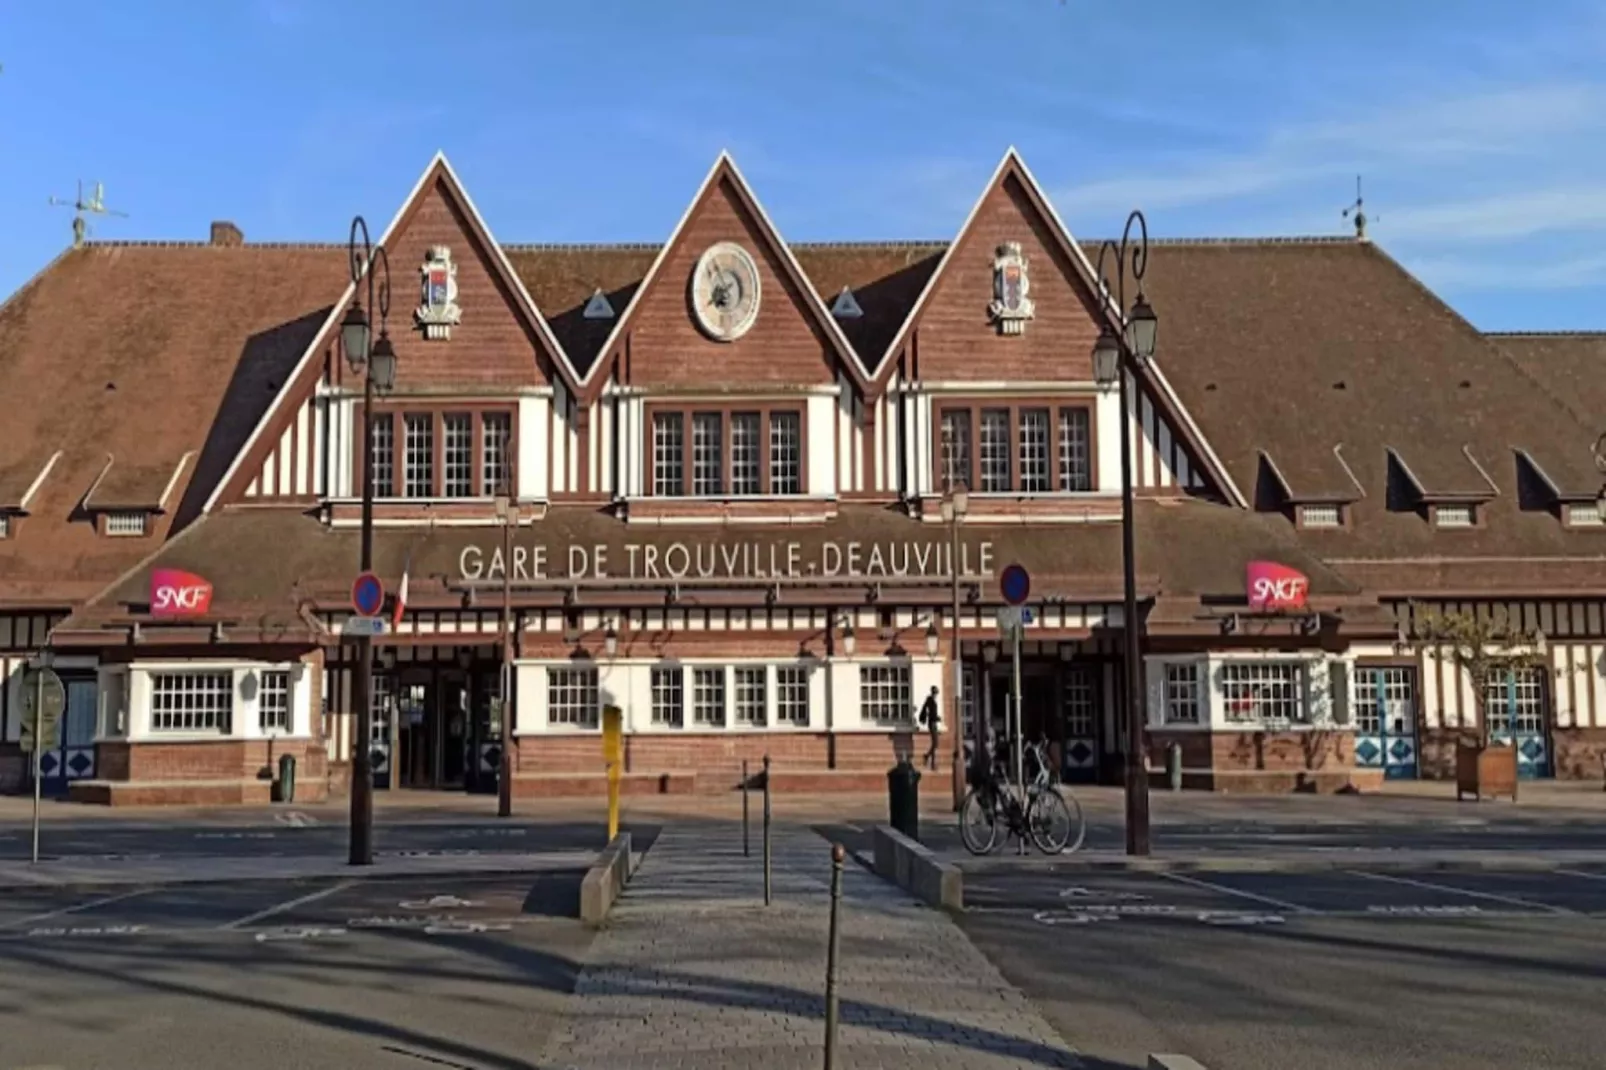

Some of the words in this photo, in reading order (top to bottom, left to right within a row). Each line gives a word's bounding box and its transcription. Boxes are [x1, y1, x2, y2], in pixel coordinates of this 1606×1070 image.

[459, 544, 548, 579] GARE
[568, 544, 608, 579] DE
[153, 584, 211, 609] SNCF
[1252, 576, 1306, 601] SNCF
